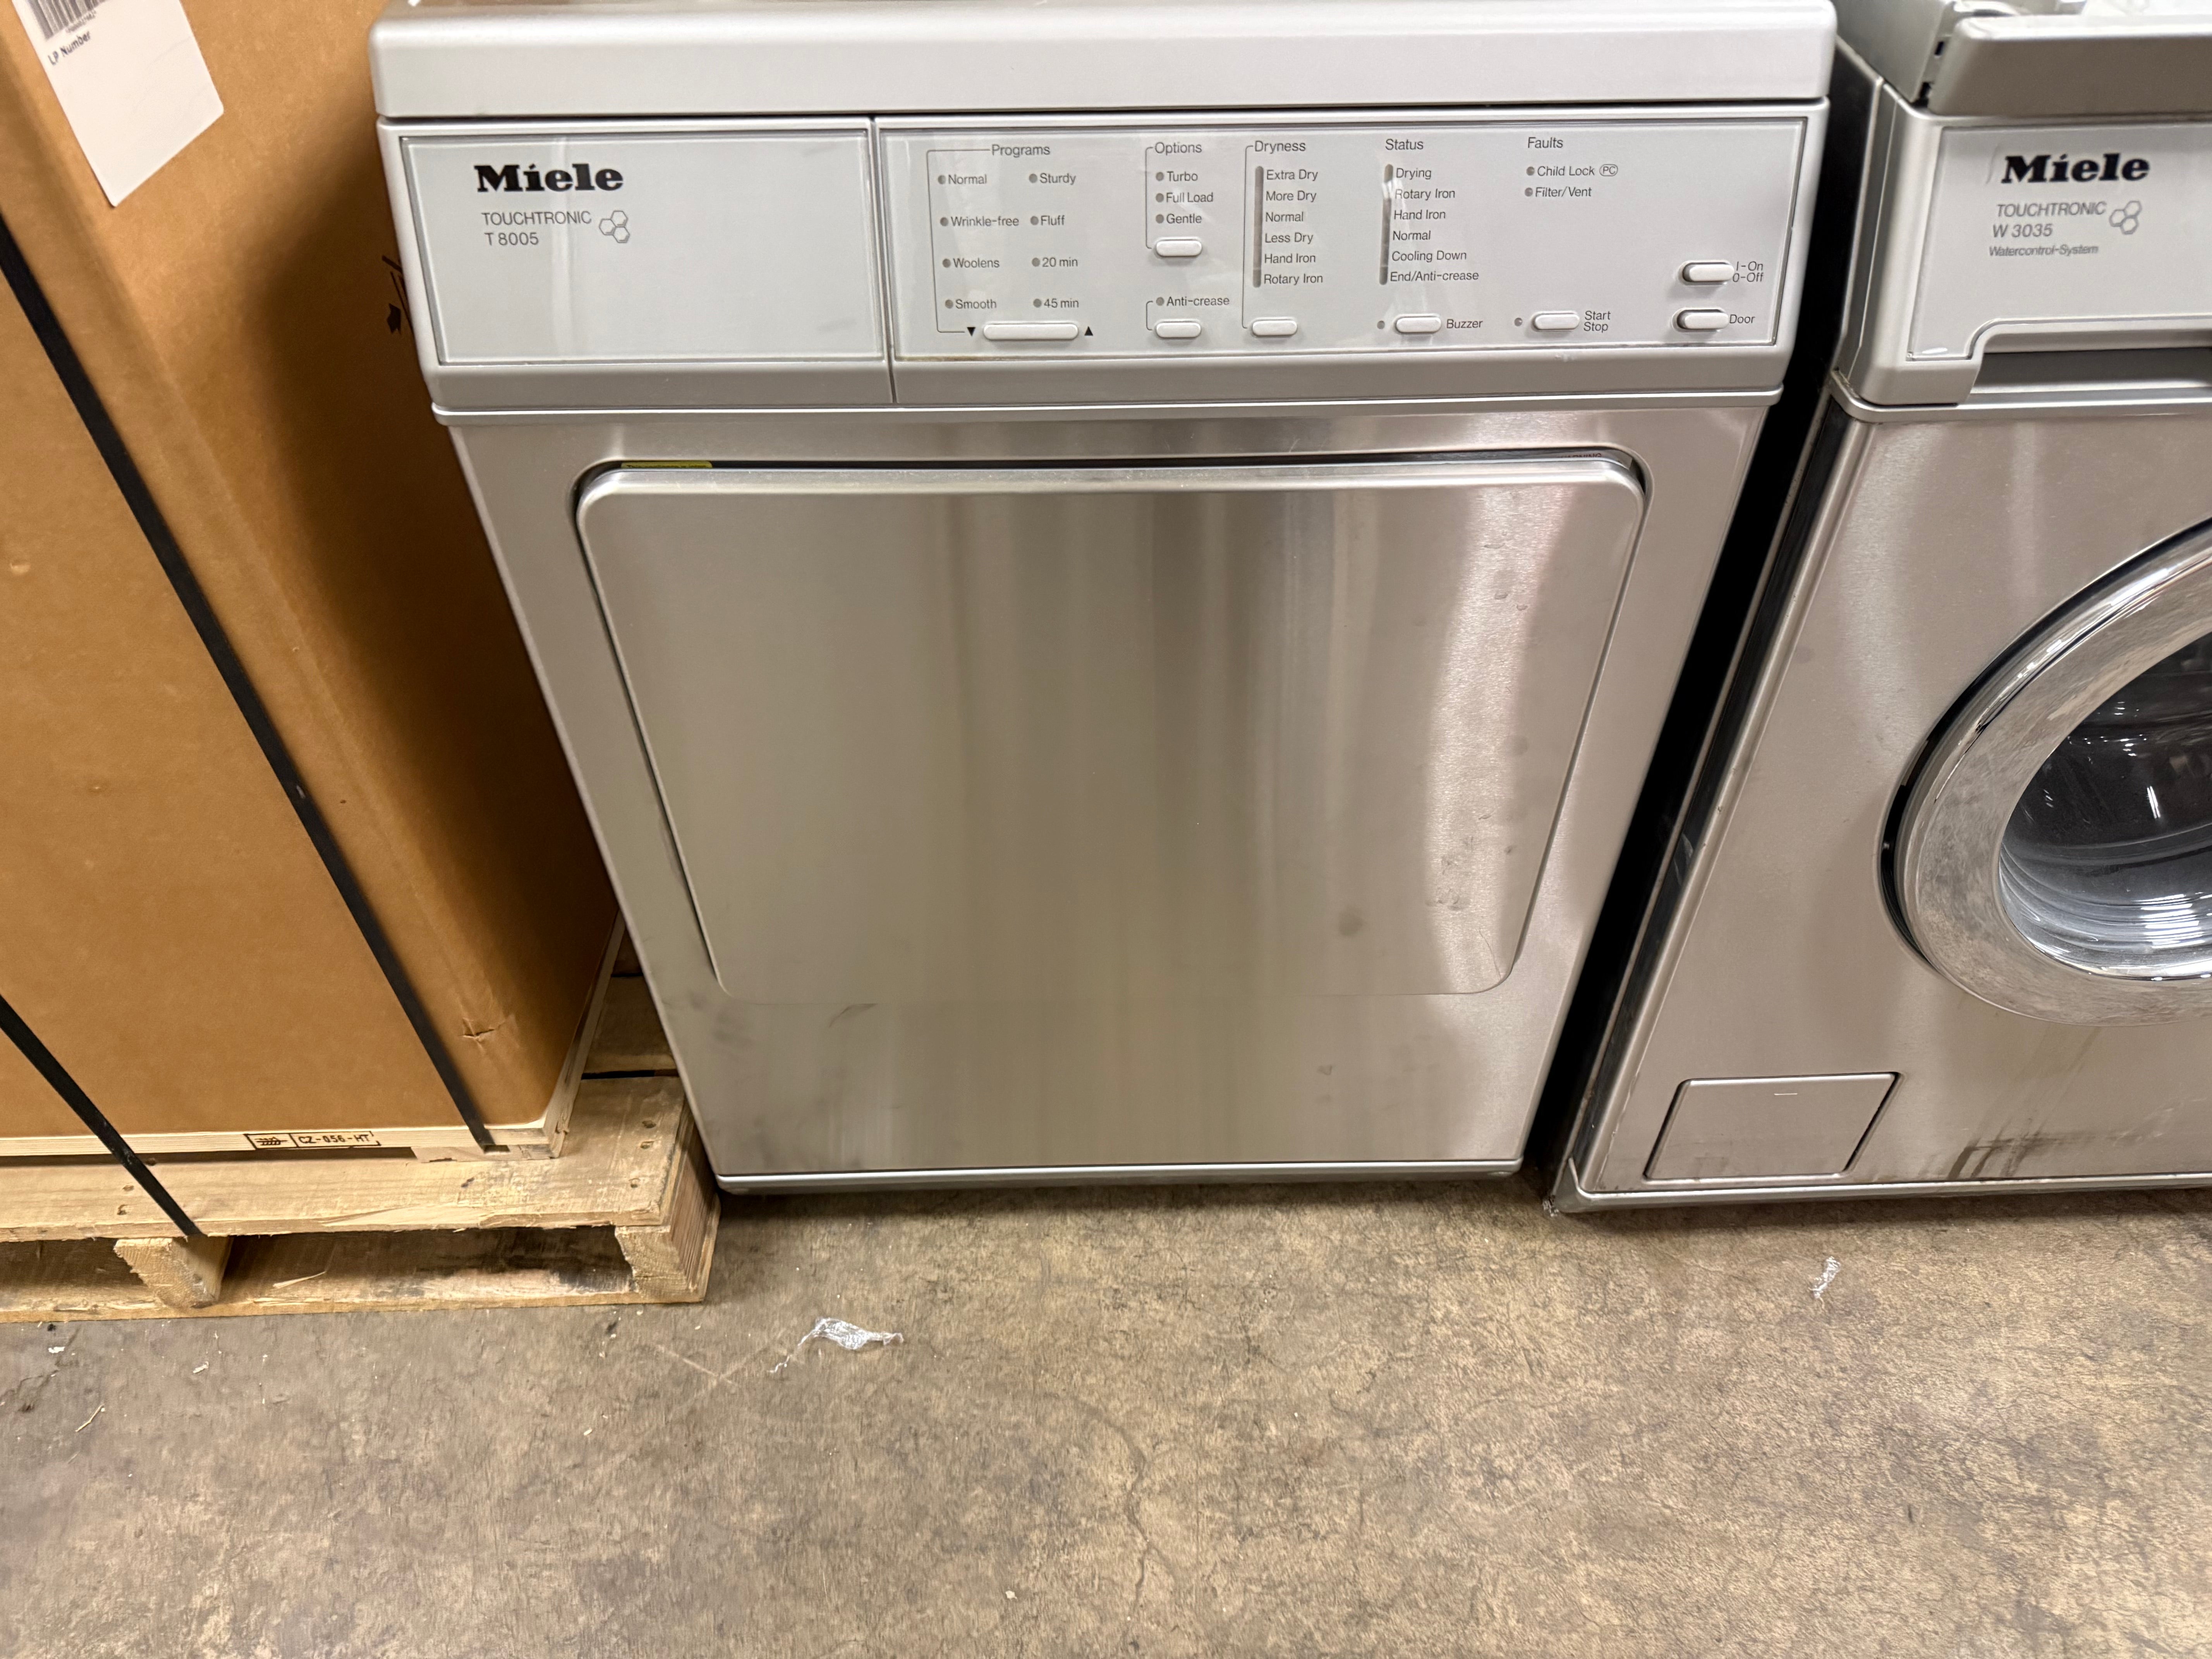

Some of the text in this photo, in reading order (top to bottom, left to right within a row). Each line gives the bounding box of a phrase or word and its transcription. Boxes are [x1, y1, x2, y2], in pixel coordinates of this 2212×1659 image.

[48, 31, 91, 66] LP Number
[1154, 141, 1202, 156] Options
[1254, 140, 1306, 155] Dryness
[1385, 138, 1424, 151] Status
[1528, 137, 1563, 149] Faults
[991, 144, 1051, 158] Programs
[1396, 167, 1432, 180] Drying
[1537, 166, 1616, 177] Child Lock PC
[2001, 153, 2150, 184] Miele
[473, 163, 623, 193] Miele
[948, 174, 987, 185] Normal
[1039, 172, 1077, 185] Sturdy
[1166, 171, 1198, 182] Turbo
[1267, 169, 1318, 182] Extra Dry
[1166, 192, 1214, 203] Full Load
[1266, 190, 1317, 203] More Dry
[1395, 188, 1455, 201] Rotary Iron
[1535, 186, 1592, 198] Filter/Vent
[1394, 209, 1446, 220] Hand Iron
[1996, 201, 2107, 218] TOUCHTRONIC
[481, 210, 592, 226] TOUCHTRONIC
[950, 215, 1019, 227] Wrinkle-free
[1041, 215, 1065, 226] Fluff
[1166, 213, 1202, 224] Gentle
[1266, 211, 1304, 222] Normal
[1393, 230, 1431, 241] Normal
[1993, 223, 2053, 238] W 3035
[484, 232, 539, 246] T 8005
[1265, 232, 1314, 245] Less Dry
[1392, 250, 1467, 263] Cooling Down
[1989, 244, 2099, 257] Watercontrol-System
[953, 258, 1000, 268] Woolens
[1042, 257, 1078, 267] 20 min
[1264, 253, 1316, 264] Hand Iron
[1264, 273, 1323, 286] Rotary Iron
[1390, 271, 1479, 282] End/Anti-crease
[955, 299, 997, 309] Smooth
[1044, 298, 1079, 308] 45 min
[1166, 296, 1230, 306] Anti-crease
[1584, 310, 1611, 321] Start
[1729, 314, 1755, 324] Door
[1446, 319, 1483, 329] Buzzer
[1583, 321, 1609, 333] Stop
